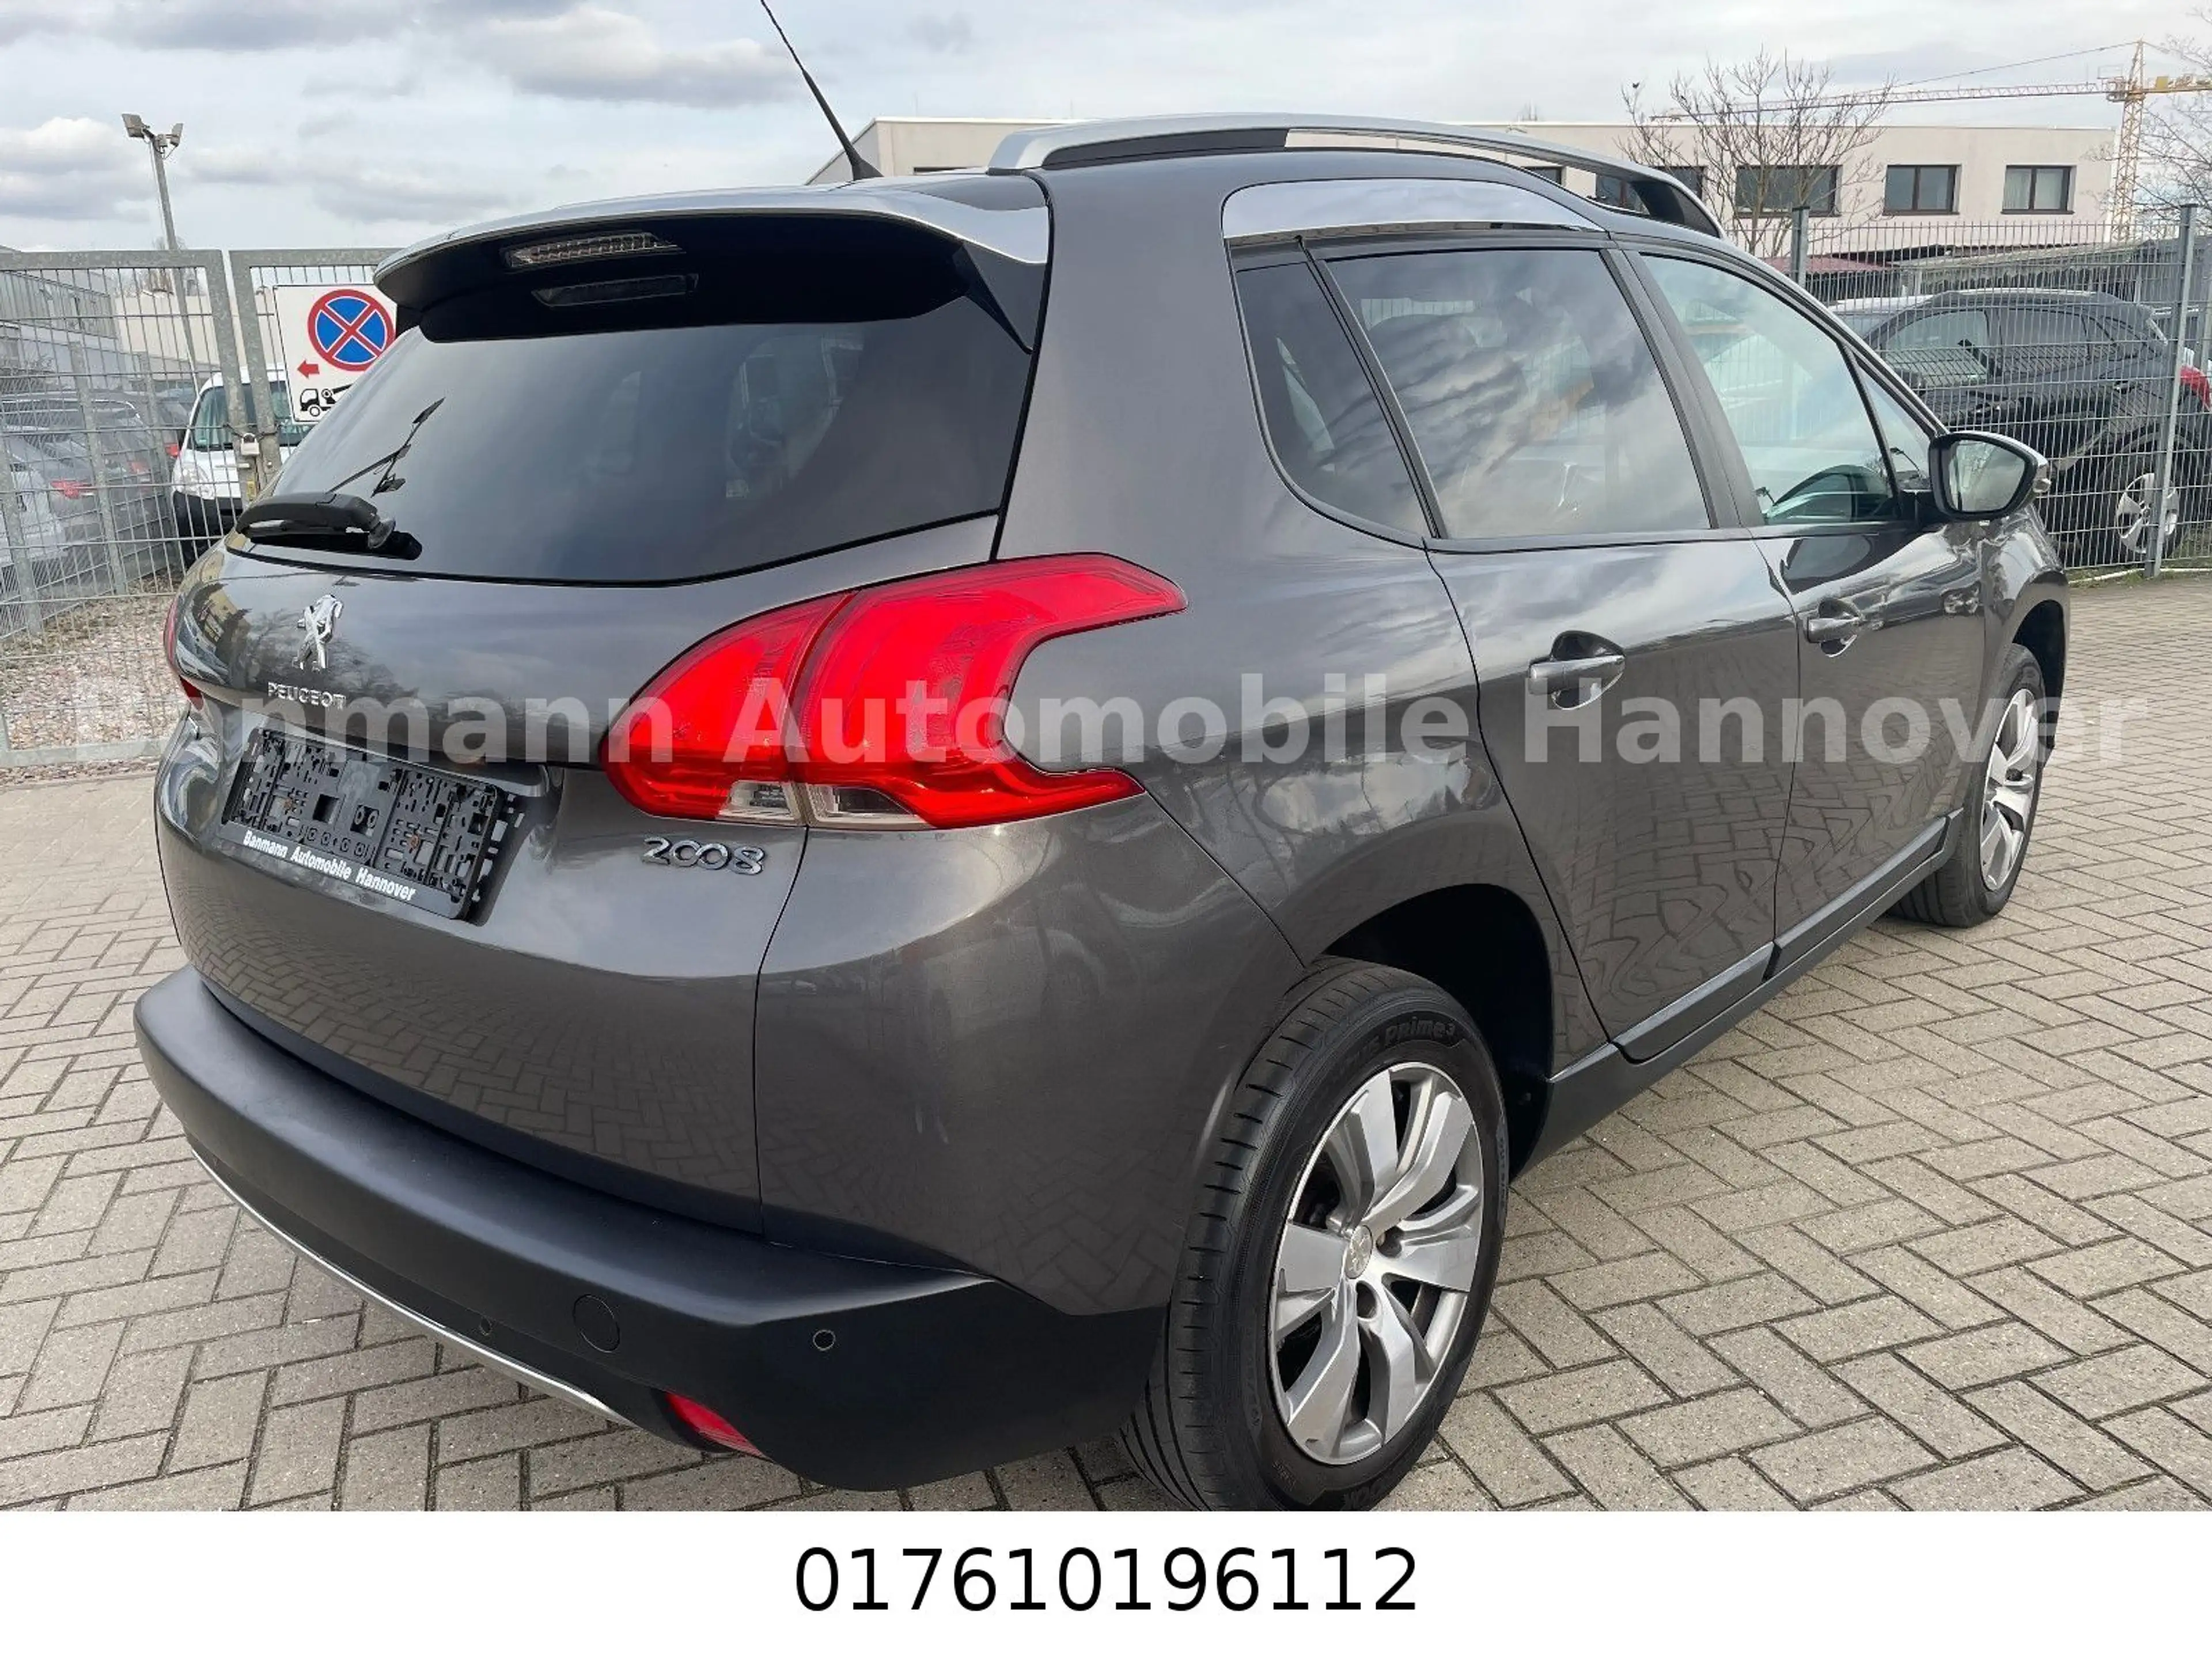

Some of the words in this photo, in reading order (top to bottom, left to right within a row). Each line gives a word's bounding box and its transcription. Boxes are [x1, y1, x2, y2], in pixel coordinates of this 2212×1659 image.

[268, 681, 346, 710] PEUGEOT
[290, 846, 352, 880] Automobile
[355, 866, 416, 901] Hannover
[642, 836, 766, 876] 2008
